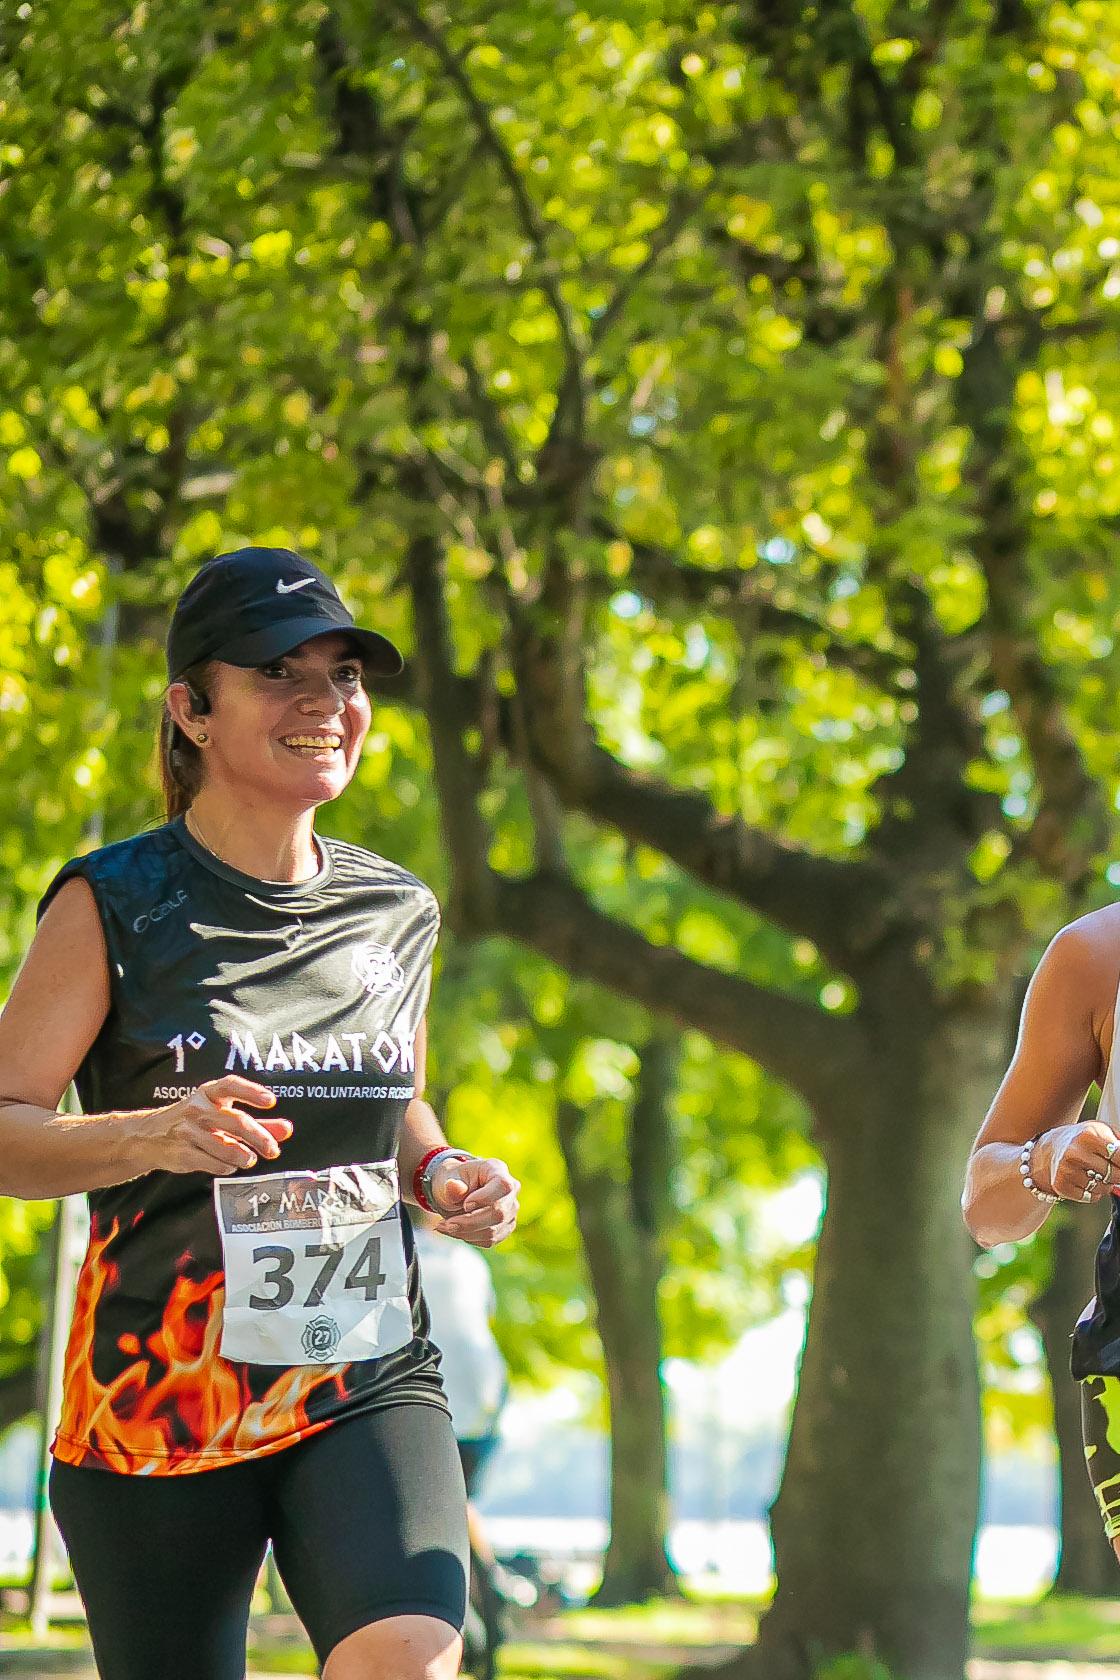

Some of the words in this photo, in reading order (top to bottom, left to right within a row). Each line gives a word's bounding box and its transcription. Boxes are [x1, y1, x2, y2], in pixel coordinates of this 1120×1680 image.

[306, 1085, 388, 1098] VOLUNTARIOS
[248, 1236, 387, 1311] 374
[314, 1329, 330, 1346] 27
